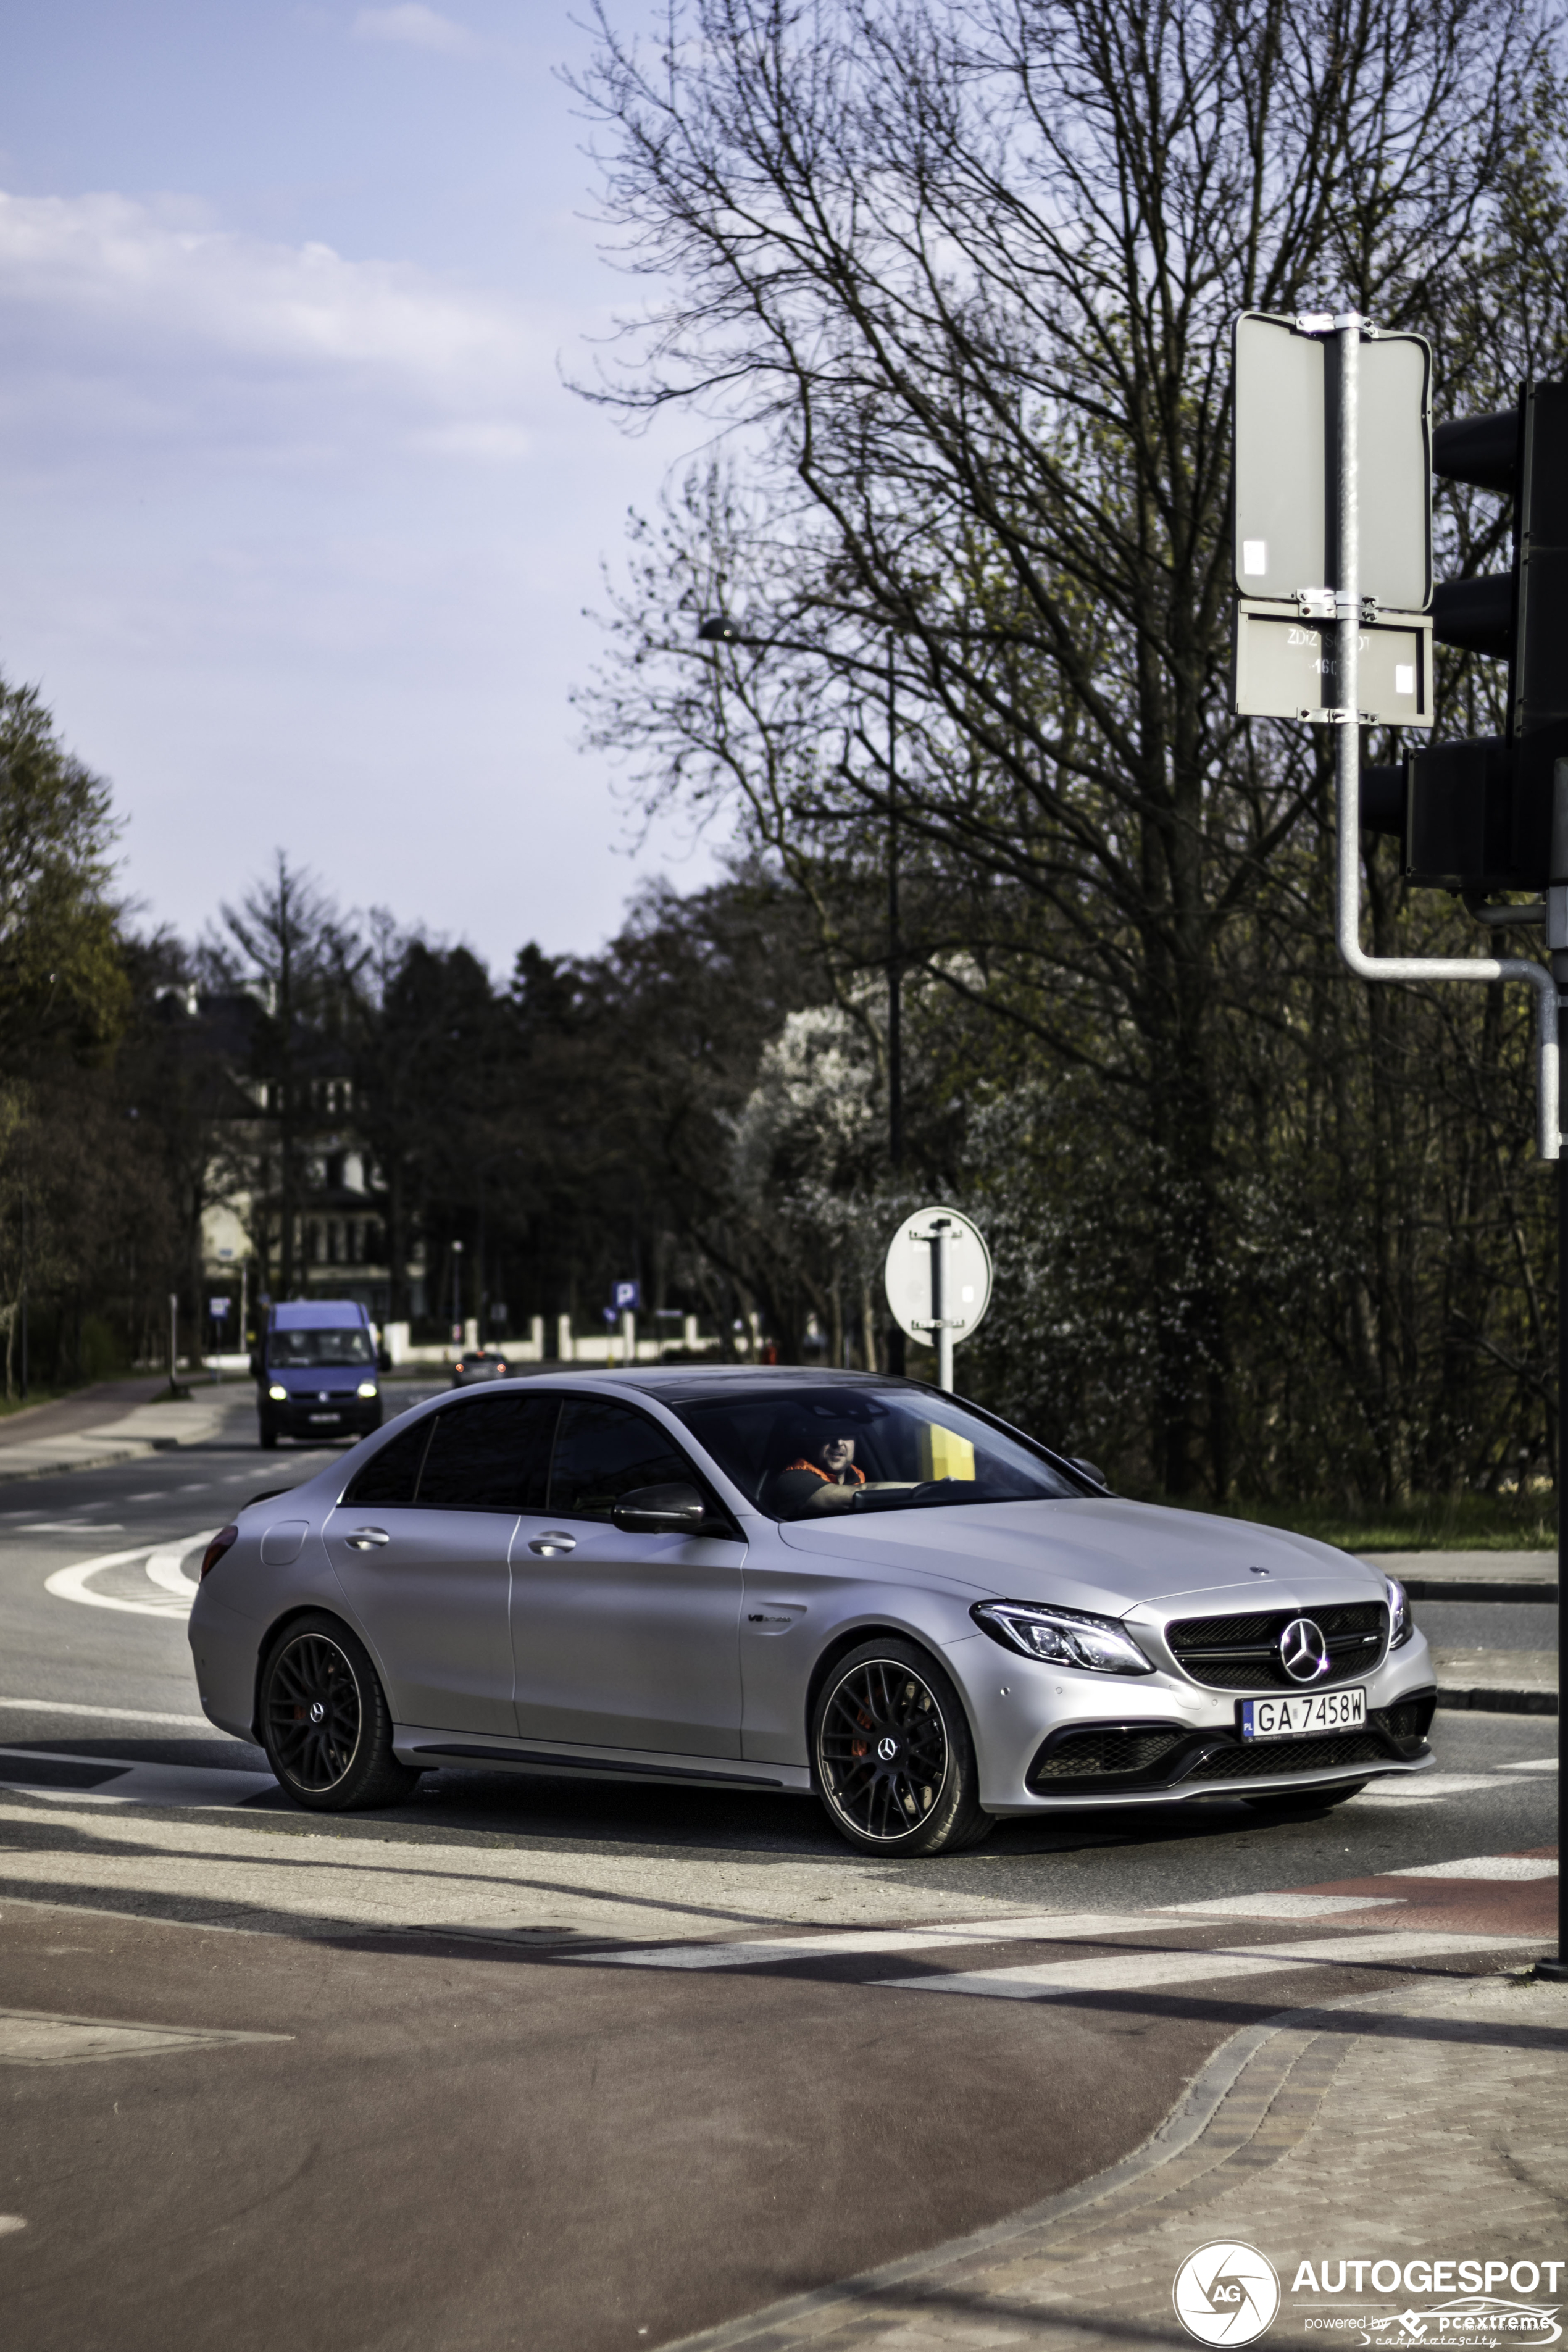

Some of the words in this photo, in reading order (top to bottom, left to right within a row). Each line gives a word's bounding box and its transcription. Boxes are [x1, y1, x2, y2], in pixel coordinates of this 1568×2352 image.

[1287, 628, 1318, 646] ZDiZ
[617, 1283, 633, 1307] P
[1243, 1723, 1253, 1731] PL
[1259, 1701, 1292, 1732] GA
[1302, 1692, 1361, 1728] 7458W
